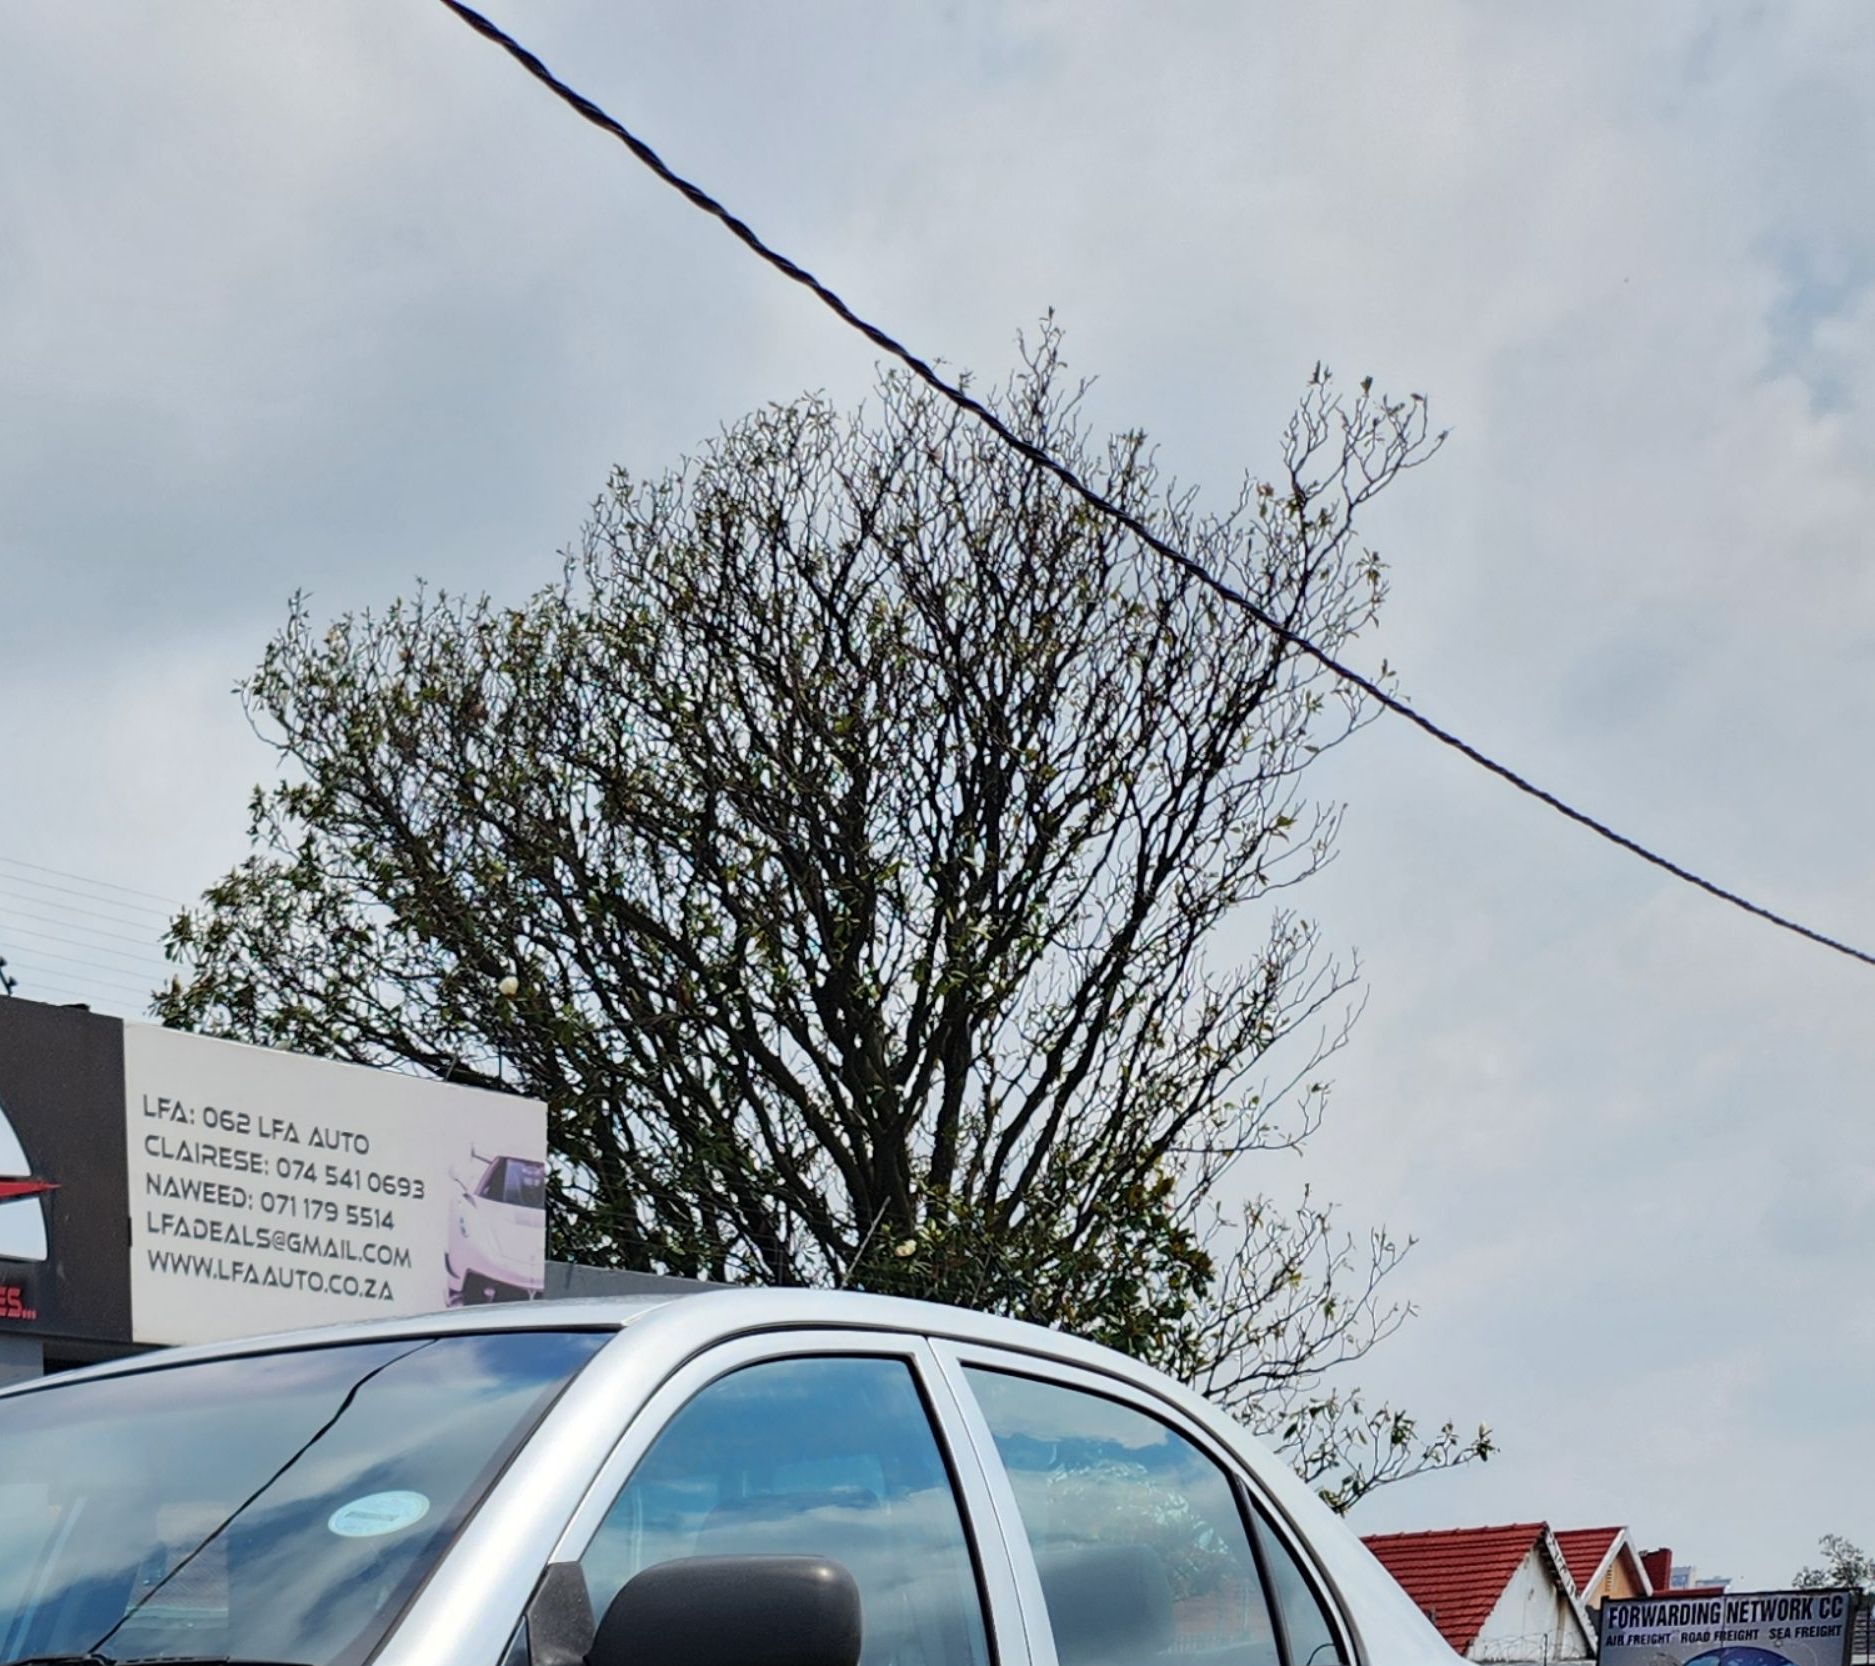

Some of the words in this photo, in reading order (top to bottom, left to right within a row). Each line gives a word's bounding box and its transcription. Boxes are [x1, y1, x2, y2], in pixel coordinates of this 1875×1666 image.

[143, 1094, 195, 1125] LFA:
[203, 1106, 251, 1135] 062
[258, 1116, 300, 1144] LFA
[308, 1126, 370, 1155] AUTO
[144, 1134, 269, 1175] CLAIRESE:
[276, 1157, 318, 1183] 074
[325, 1164, 361, 1190] 541
[367, 1171, 425, 1200] 0693
[146, 1172, 253, 1210] NAWEED:
[260, 1191, 296, 1217] 071
[303, 1197, 339, 1222] 179
[346, 1204, 395, 1230] 5514
[147, 1211, 411, 1268] LFADEALS@GMAIL.COM
[147, 1249, 394, 1301] WWW.LFAAUTO.CO.ZA
[1605, 1634, 1625, 1647] AIR
[1627, 1632, 1672, 1646] FREIGHT
[1680, 1630, 1710, 1644] ROAD
[1713, 1628, 1760, 1642] FREIGHT
[1769, 1626, 1792, 1640] SEA
[1794, 1624, 1844, 1639] FREIGHT
[1608, 1602, 1721, 1629] FORWARDING
[1726, 1596, 1813, 1624] NETWORK
[1818, 1595, 1844, 1620] CC
